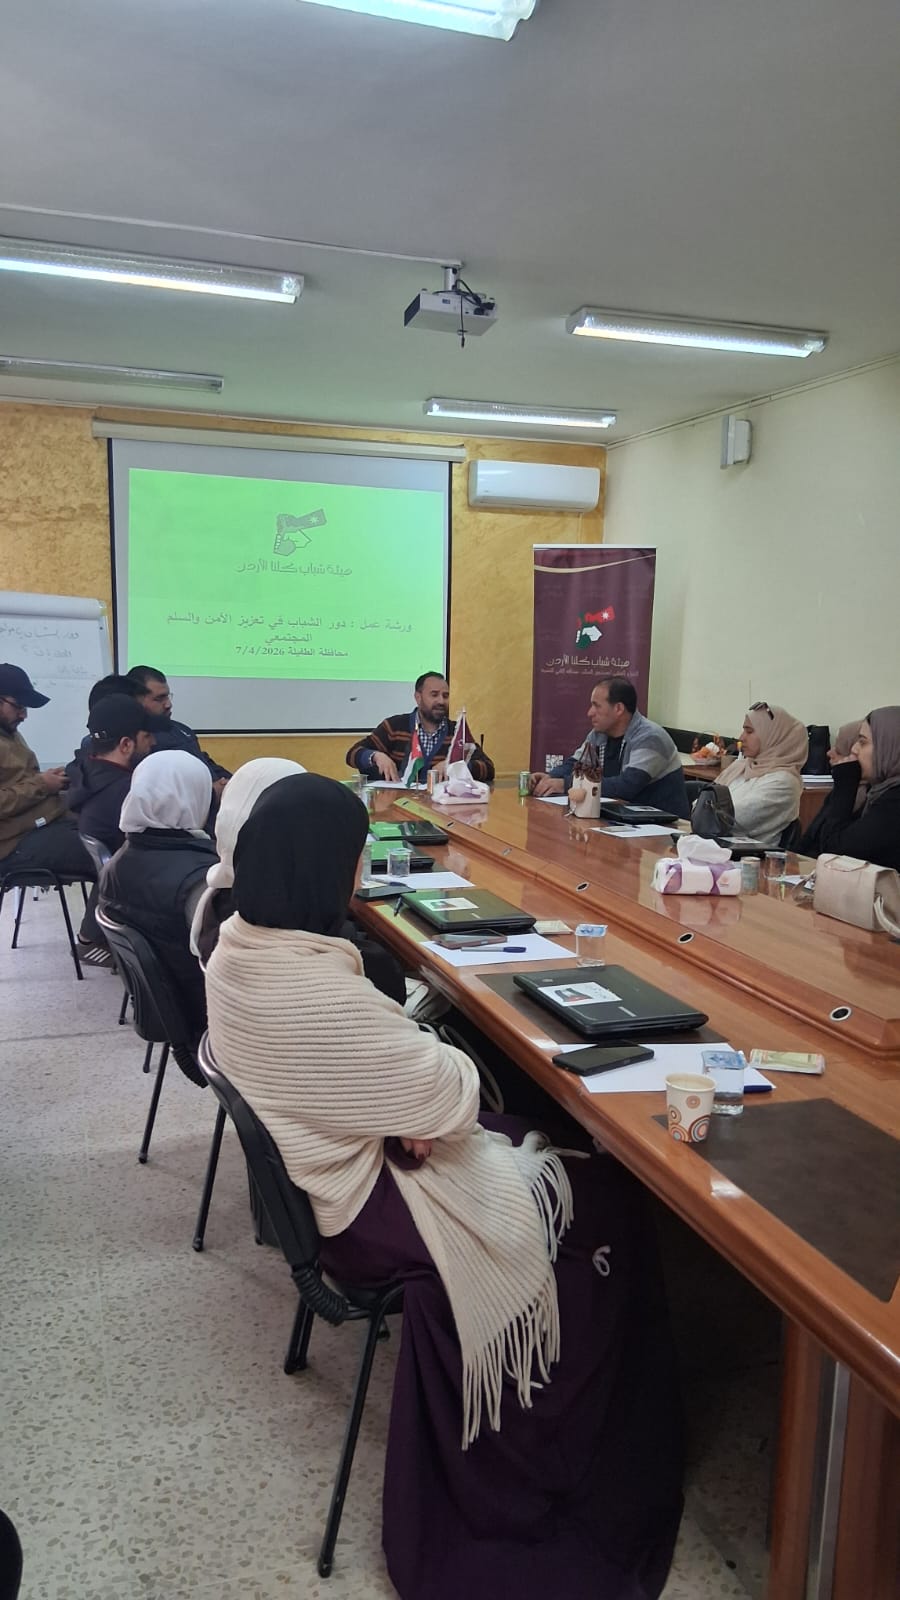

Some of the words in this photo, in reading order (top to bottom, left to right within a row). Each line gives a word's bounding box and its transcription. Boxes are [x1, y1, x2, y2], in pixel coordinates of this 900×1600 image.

[271, 560, 298, 574] كلنا
[300, 563, 325, 576] شباب
[167, 611, 200, 624] والسلم
[205, 611, 231, 625] الأمن
[237, 615, 264, 629] تعزيز
[268, 616, 284, 630] في
[288, 617, 321, 628] الشباب
[328, 621, 346, 630] دور
[360, 619, 380, 630] عمل
[385, 618, 412, 632] ورشة
[265, 633, 312, 645] المجتمعي
[235, 646, 285, 656] 7/4/2026
[288, 646, 315, 657] الطفيلة
[319, 648, 348, 657] محافظة
[546, 654, 570, 666] الأردن
[570, 655, 590, 666] كلنا
